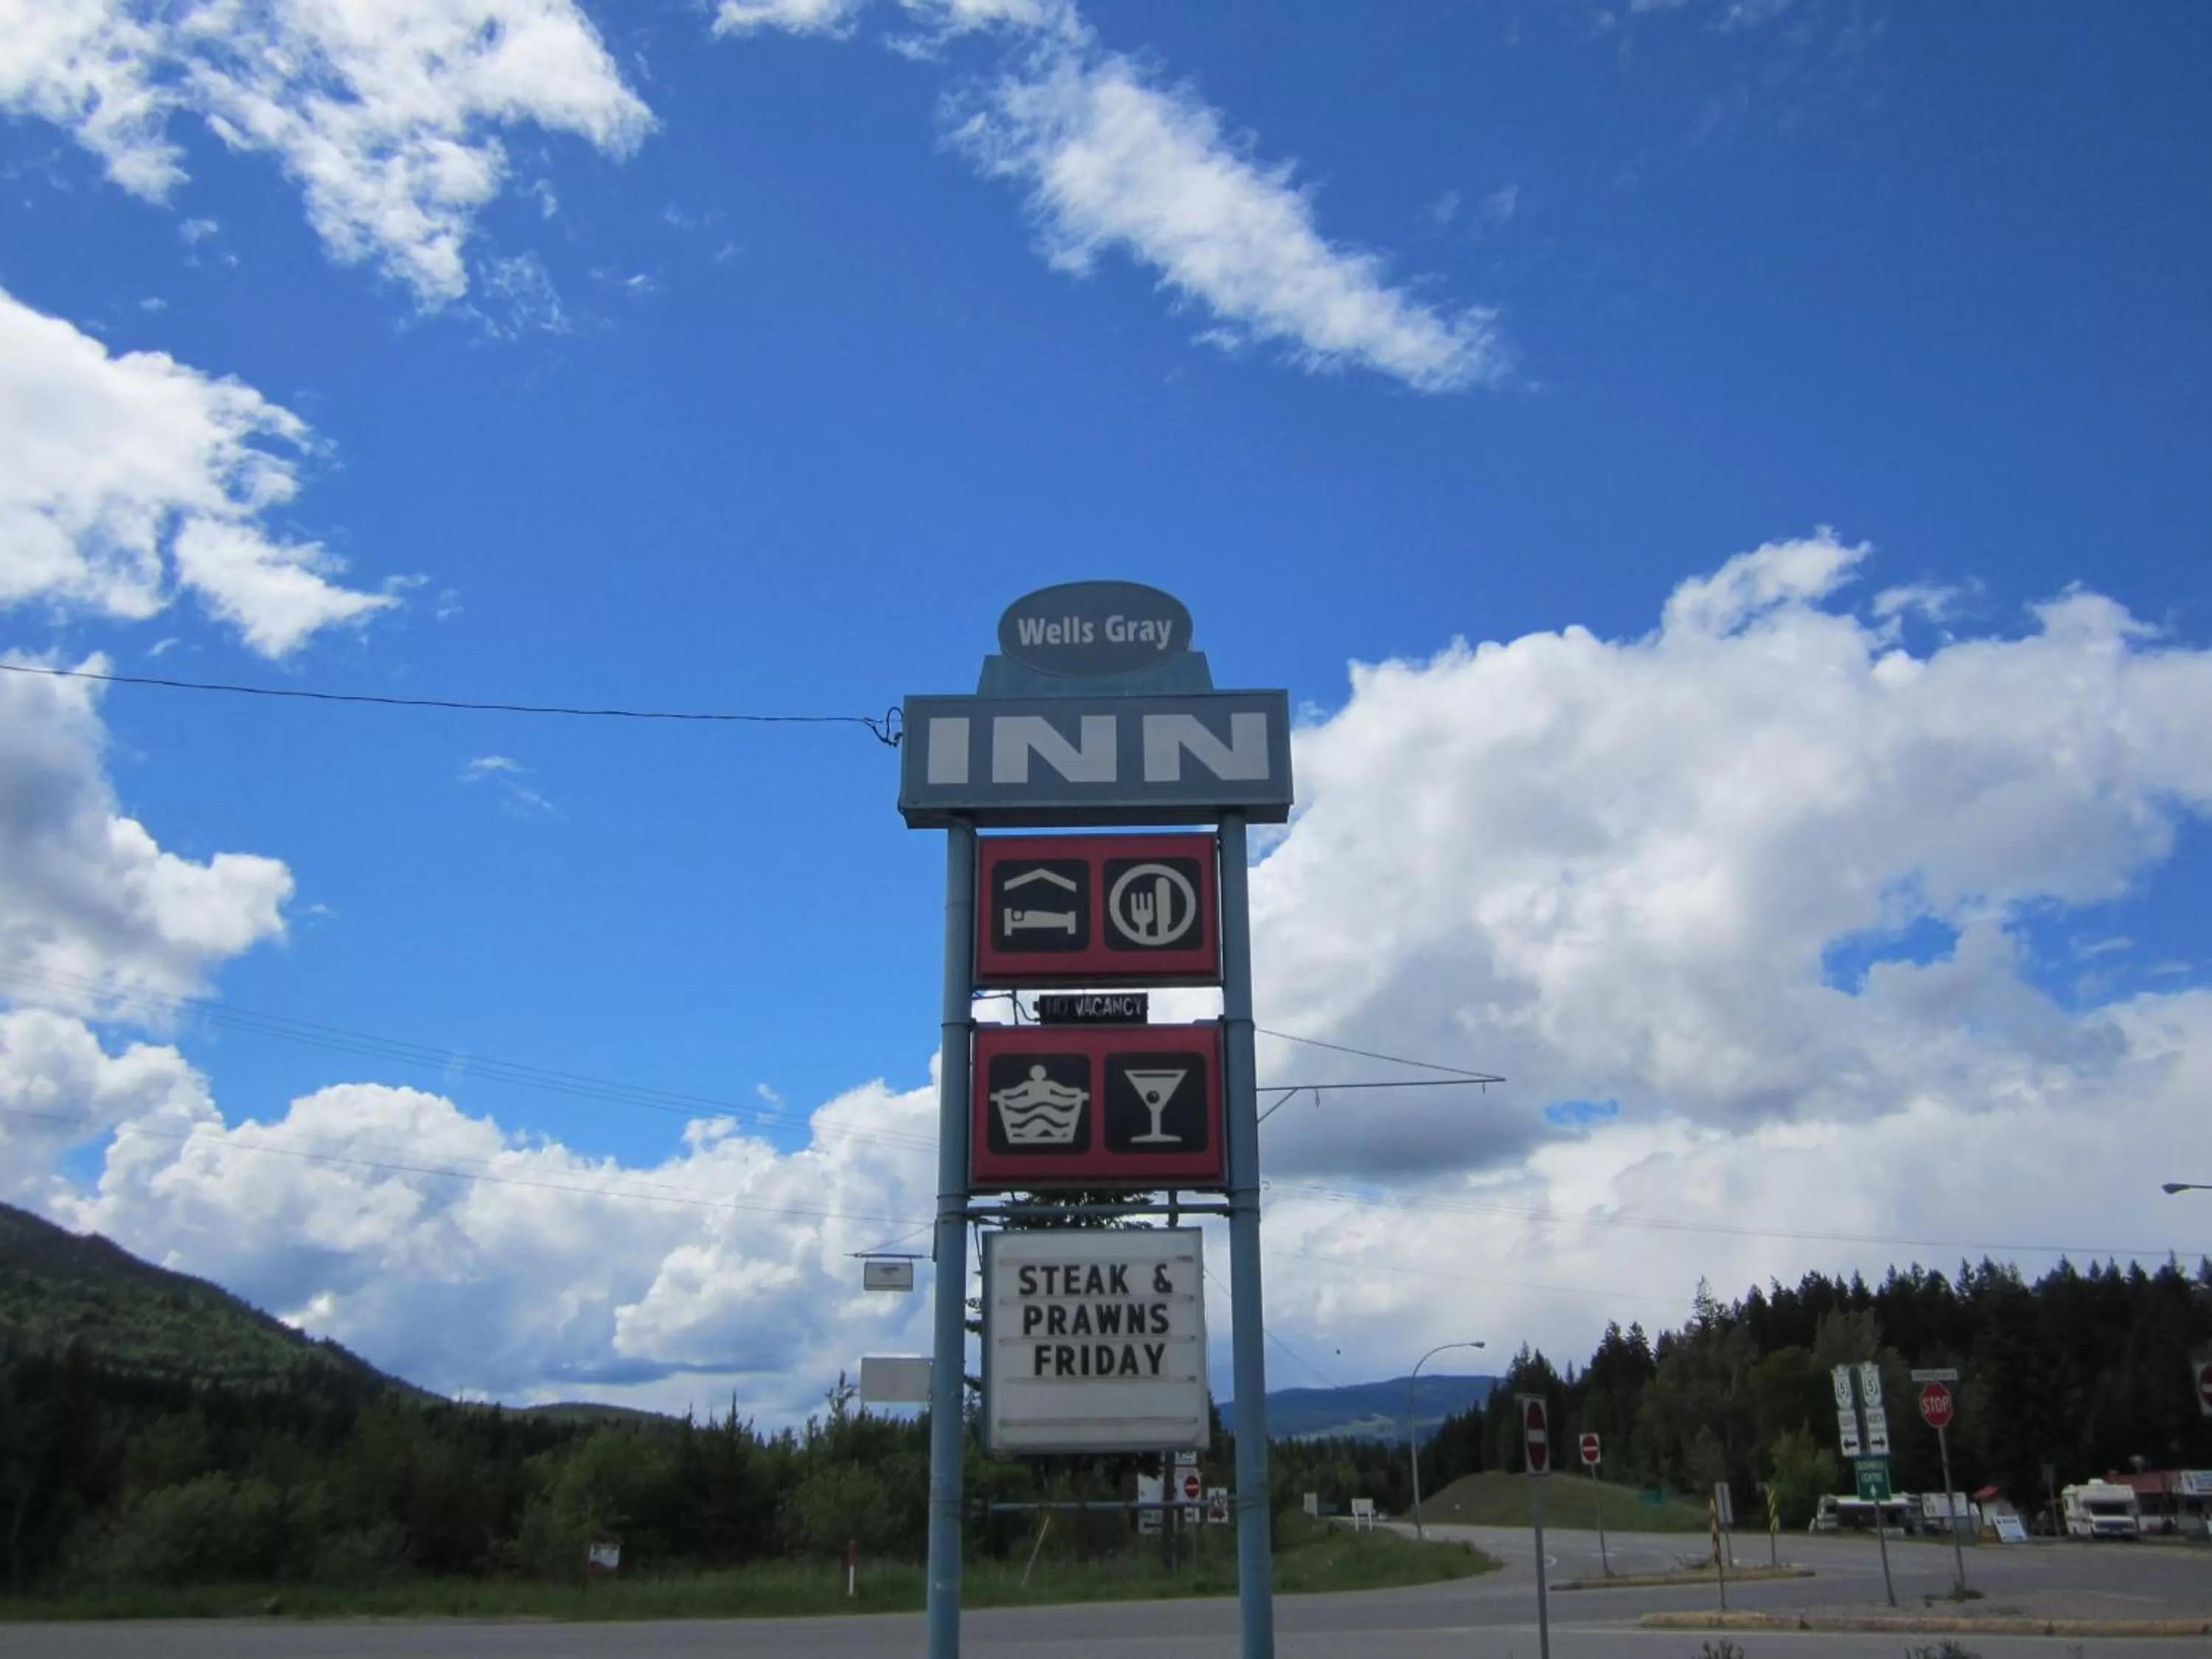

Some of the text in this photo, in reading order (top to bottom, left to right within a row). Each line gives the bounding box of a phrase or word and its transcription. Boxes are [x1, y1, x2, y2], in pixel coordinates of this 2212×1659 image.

[1018, 614, 1173, 650] Wells Gray
[928, 712, 1269, 785] INN
[1076, 996, 1141, 1016] VACANCY
[1018, 1263, 1172, 1295] STEAK &
[1023, 1303, 1170, 1335] PRAWNS
[1034, 1343, 1166, 1377] FRIDAY
[1922, 1395, 1949, 1414] STOP
